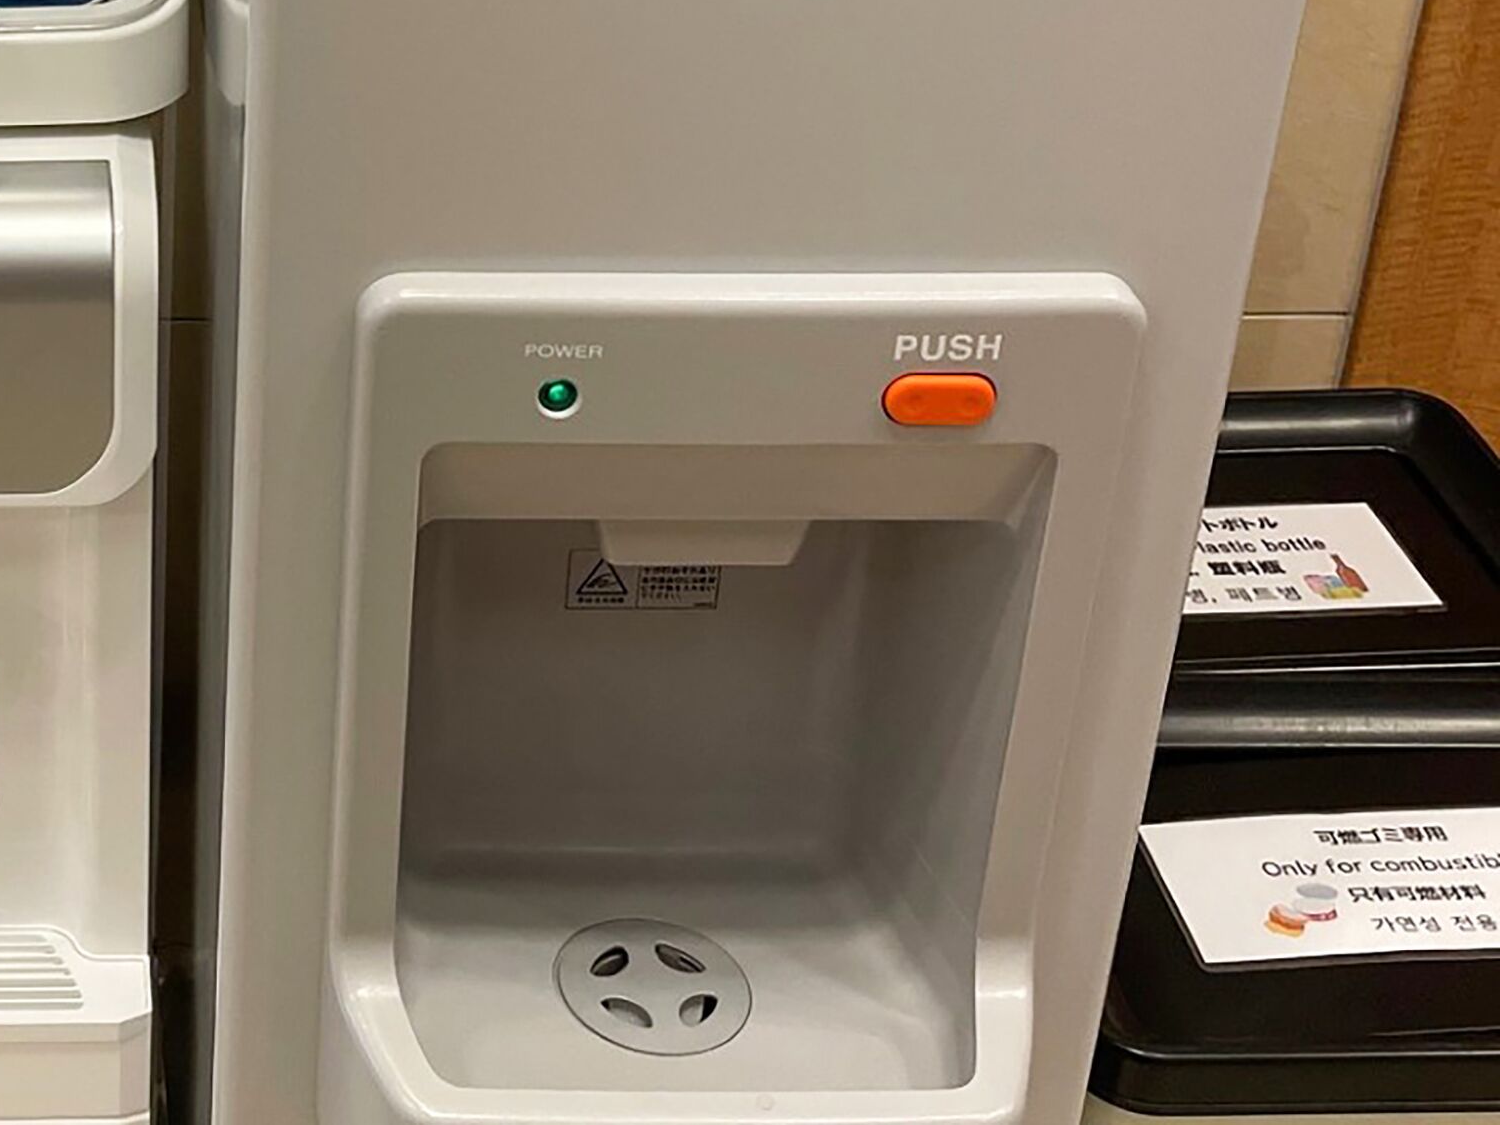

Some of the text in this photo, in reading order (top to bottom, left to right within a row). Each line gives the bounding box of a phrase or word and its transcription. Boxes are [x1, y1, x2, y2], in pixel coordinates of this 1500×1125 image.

[525, 343, 603, 359] POWER
[893, 335, 1002, 362] PUSH
[1196, 537, 1326, 554] lastic bottle
[1313, 826, 1448, 845] 可燃ゴミ専用
[1262, 853, 1500, 877] Only for combustib
[1348, 884, 1486, 903] 只有可燃材料
[1371, 914, 1498, 932] 가연성 전용
